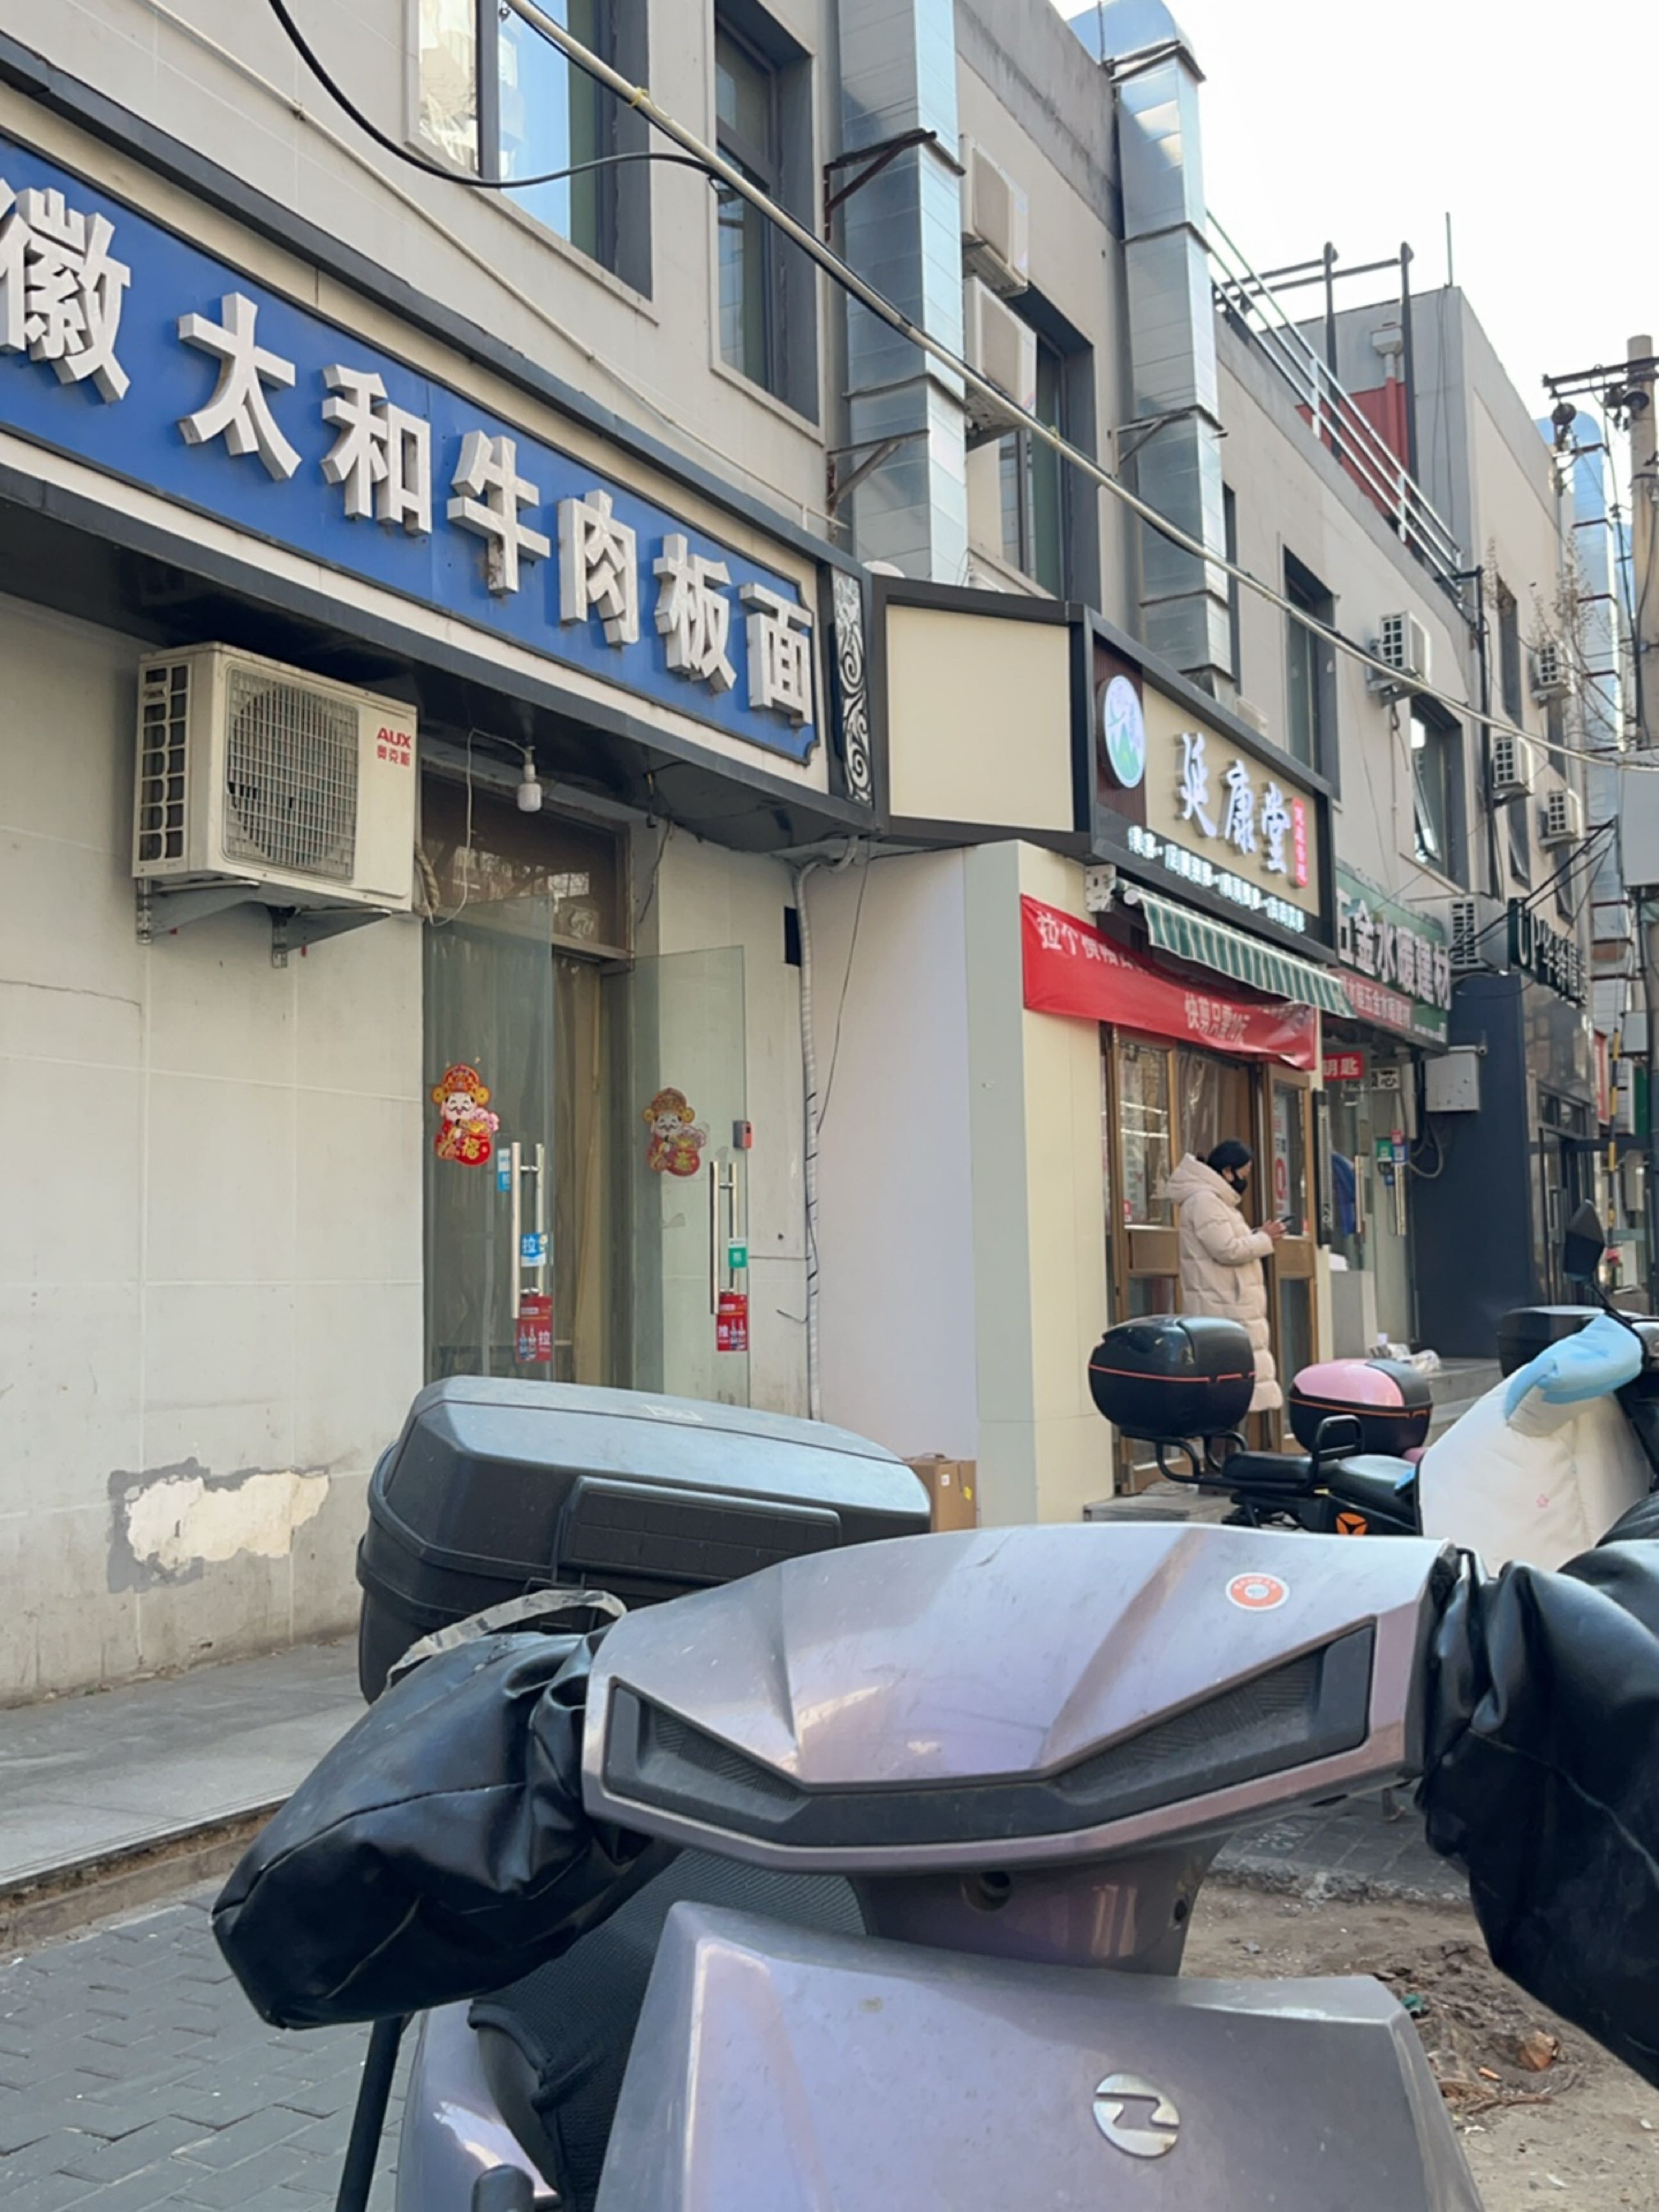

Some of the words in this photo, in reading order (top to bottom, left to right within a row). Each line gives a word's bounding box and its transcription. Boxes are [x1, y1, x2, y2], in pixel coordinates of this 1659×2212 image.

[0, 179, 814, 726] 徽太和牛肉板面
[378, 727, 411, 749] AUX
